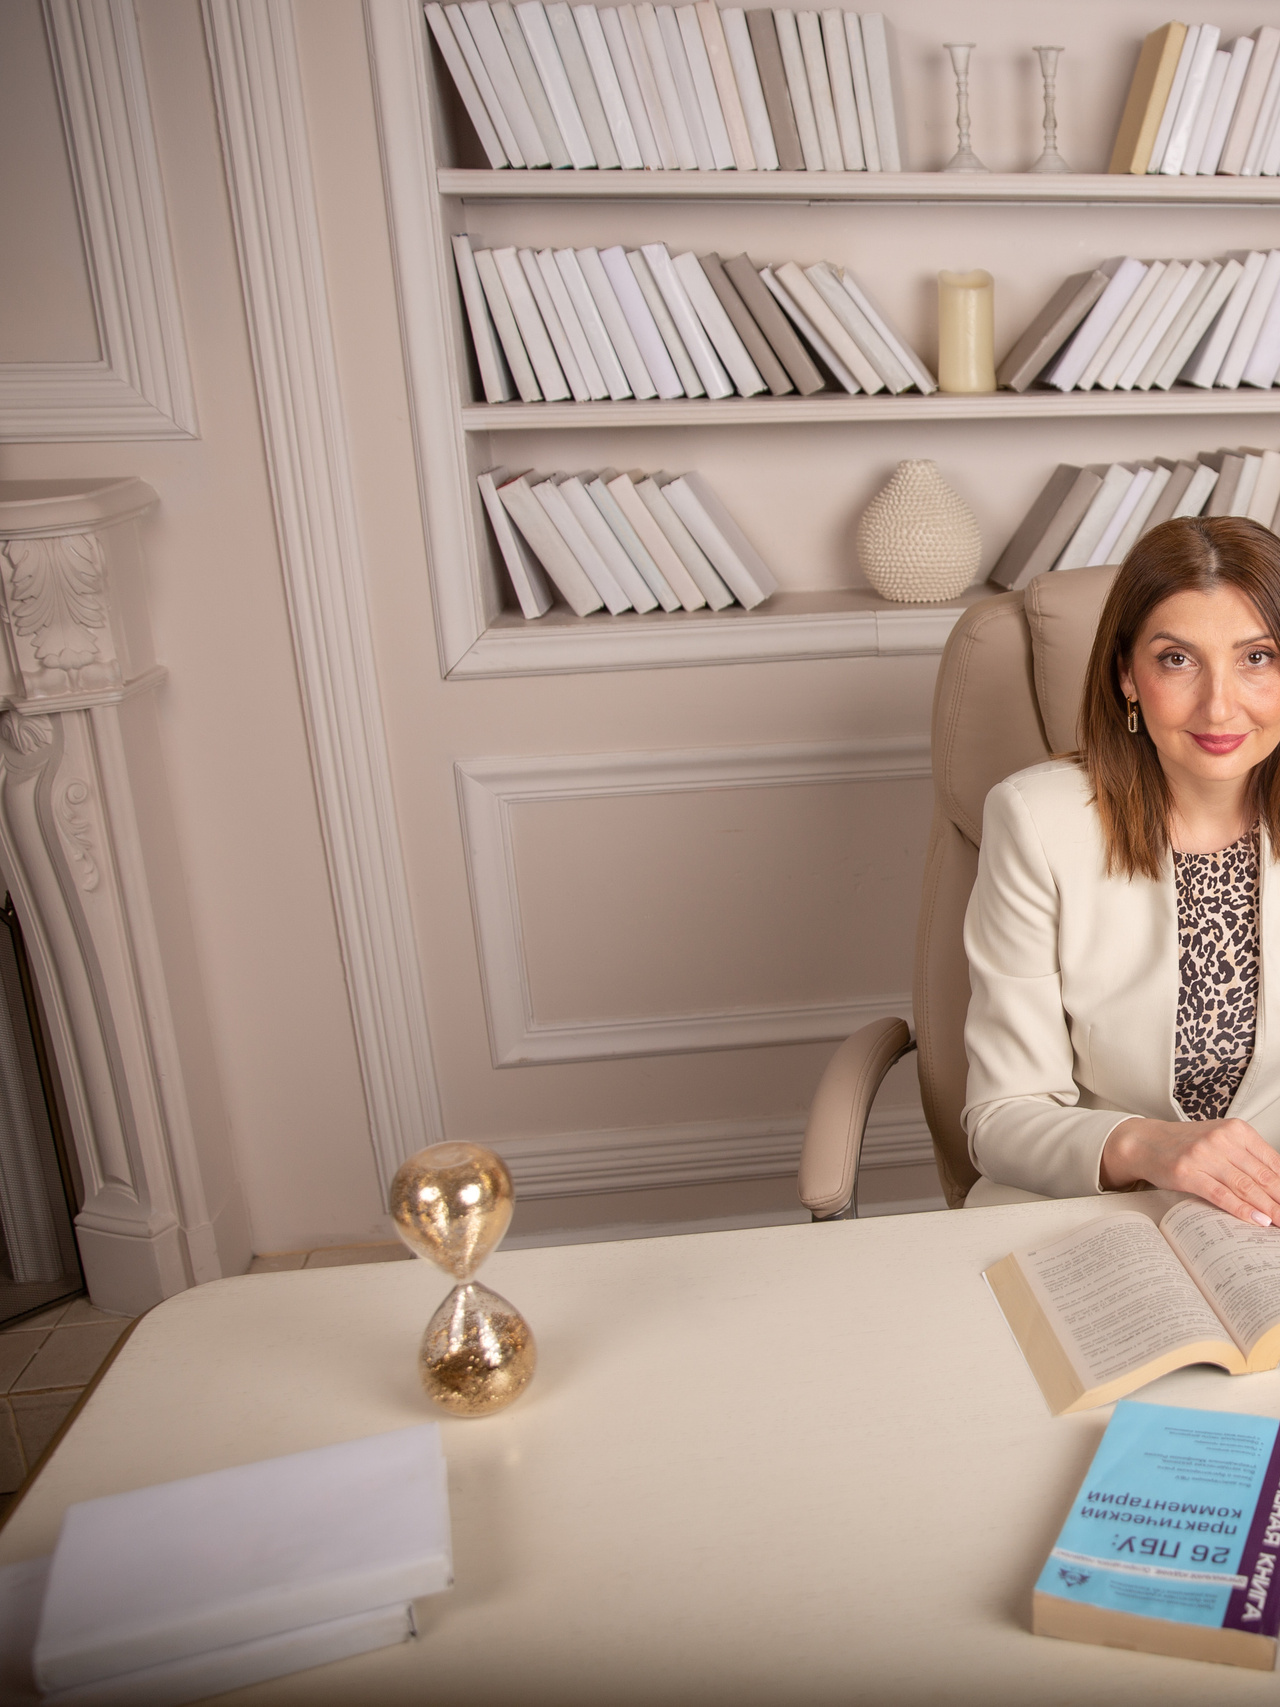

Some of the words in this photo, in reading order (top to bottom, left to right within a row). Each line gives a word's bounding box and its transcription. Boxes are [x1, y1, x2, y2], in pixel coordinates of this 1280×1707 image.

[1086, 1490, 1242, 1519] комментарий
[1080, 1506, 1238, 1536] практический
[1111, 1534, 1181, 1558] ПБУ:
[1190, 1544, 1230, 1564] 26
[1241, 1552, 1276, 1622] КНИГА
